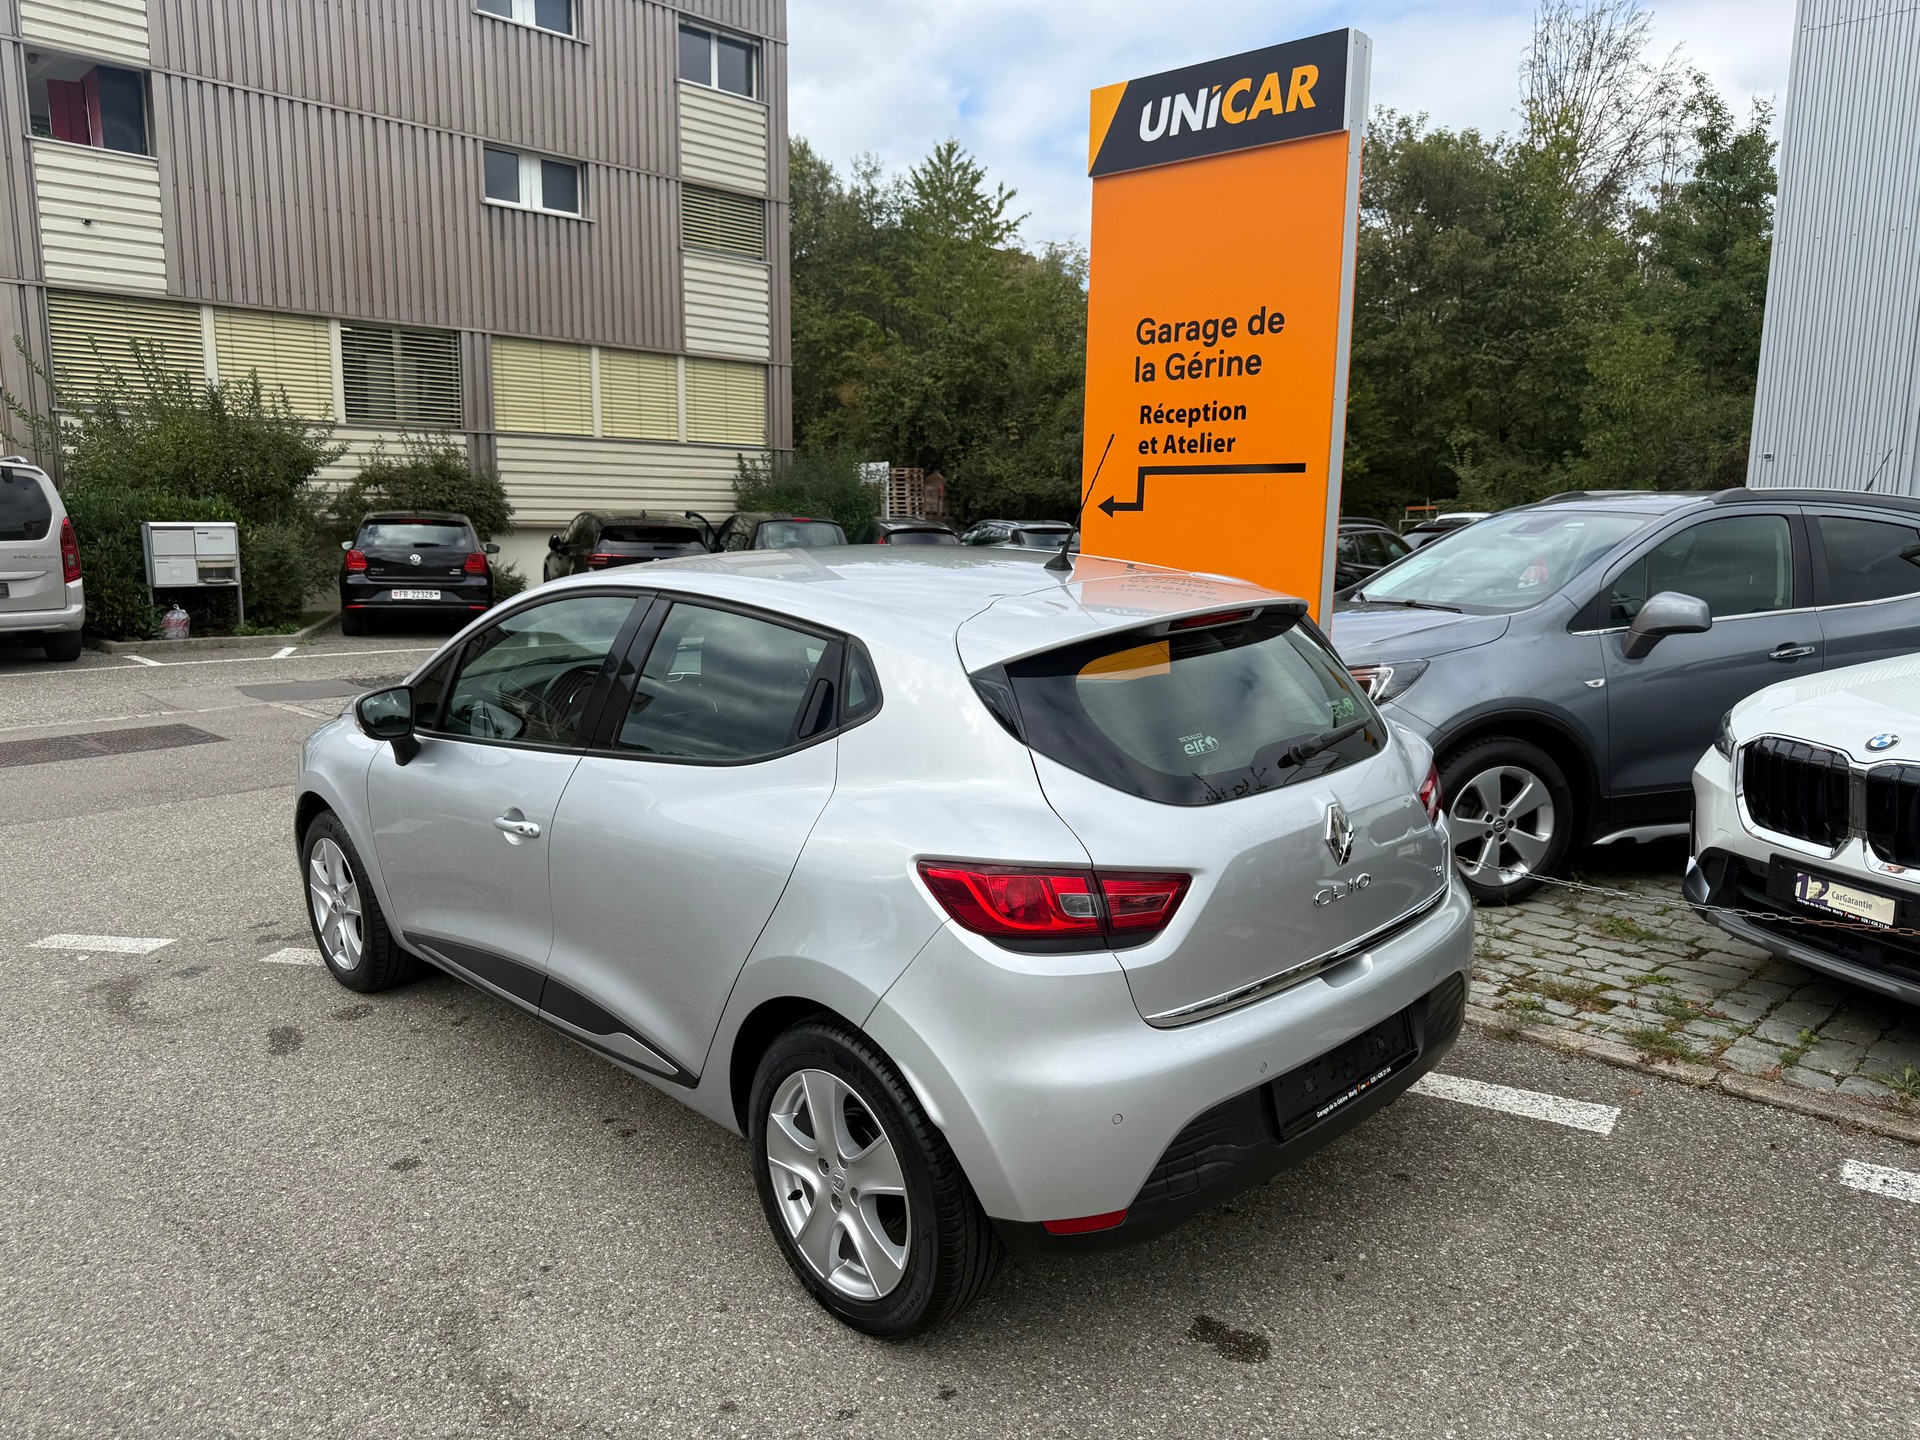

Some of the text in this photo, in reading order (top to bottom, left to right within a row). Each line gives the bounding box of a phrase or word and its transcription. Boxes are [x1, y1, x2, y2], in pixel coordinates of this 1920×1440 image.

[1136, 306, 1286, 348] Garage de
[1134, 348, 1262, 383] la Gérine
[1139, 400, 1248, 427] Réception
[1138, 432, 1237, 455] et Atelier
[1178, 732, 1204, 742] RENAULT
[1184, 739, 1206, 755] elf
[1313, 872, 1371, 908] CLIO
[1832, 891, 1873, 910] CarGarantie
